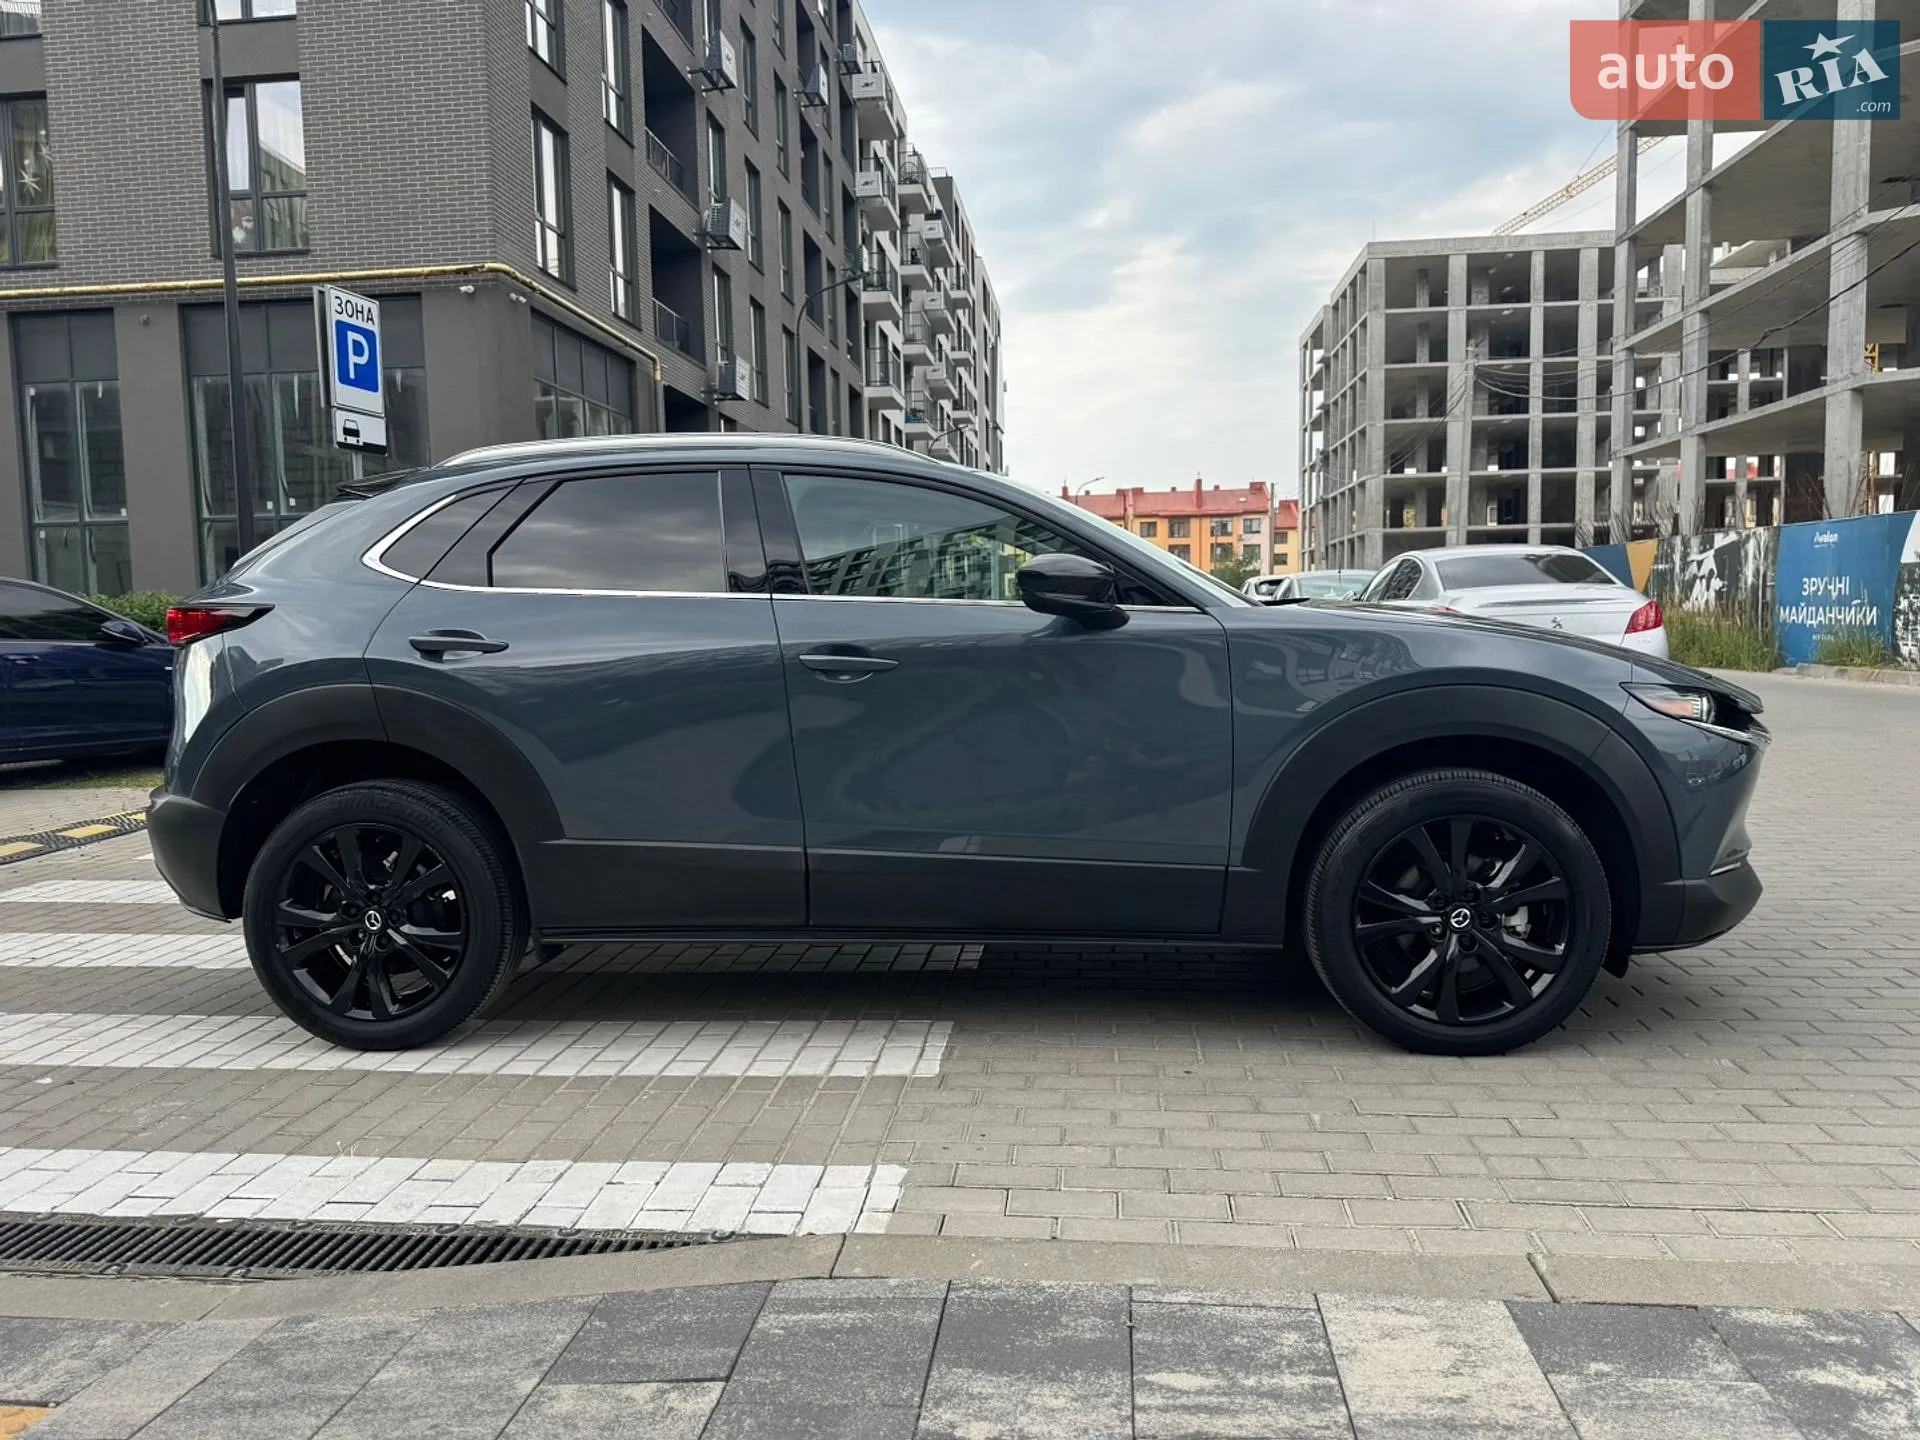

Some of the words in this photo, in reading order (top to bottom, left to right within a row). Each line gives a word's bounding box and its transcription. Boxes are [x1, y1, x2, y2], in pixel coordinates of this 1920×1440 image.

[334, 296, 375, 325] ЗОНА
[346, 330, 369, 380] P
[1801, 575, 1850, 596] ЗРУЧНІ
[1779, 601, 1878, 629] МАЙДАНЧИКИ
